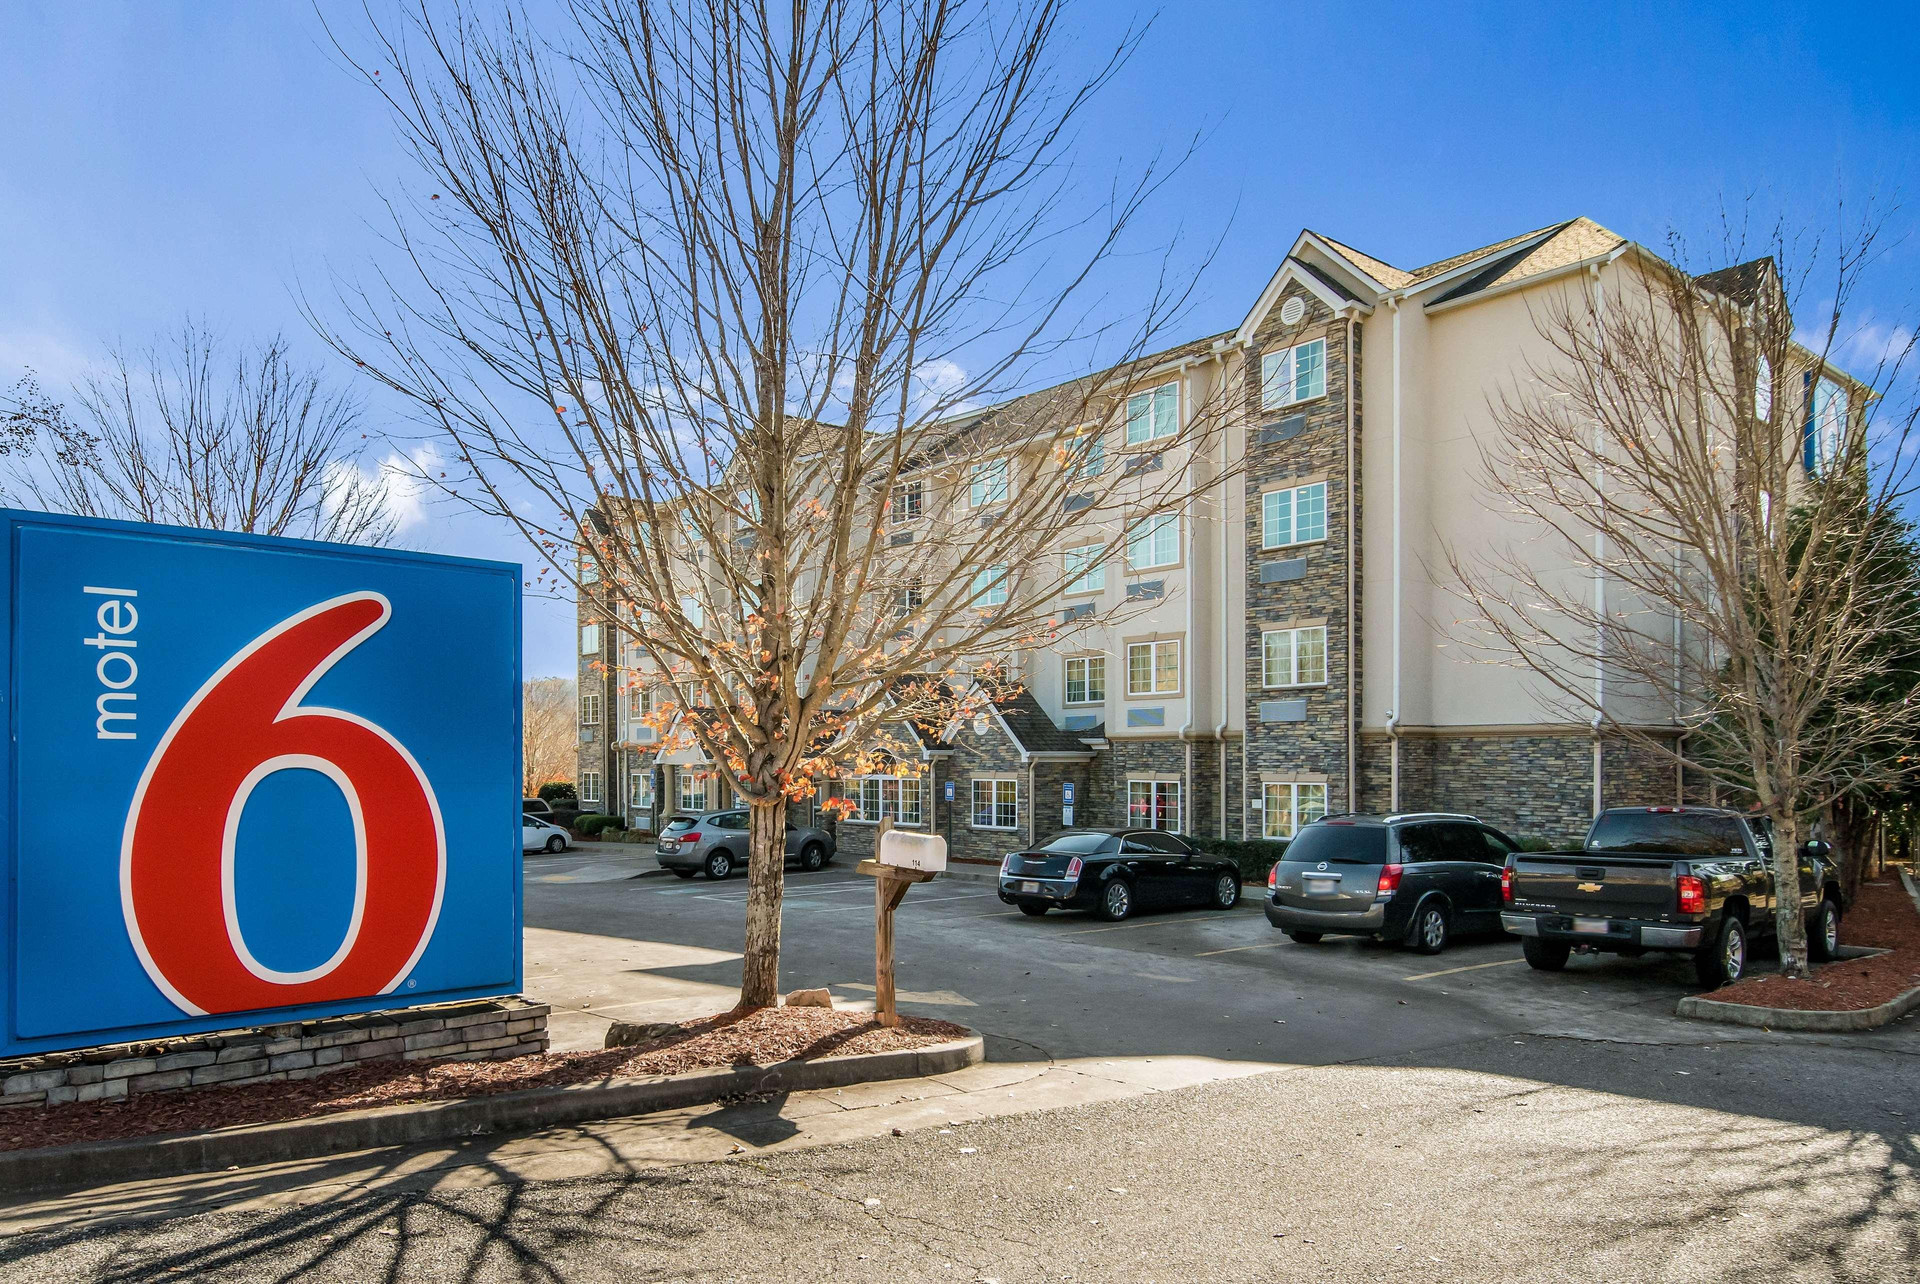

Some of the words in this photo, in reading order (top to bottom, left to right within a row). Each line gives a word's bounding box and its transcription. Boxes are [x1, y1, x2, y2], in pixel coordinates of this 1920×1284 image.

[82, 585, 139, 740] motel
[119, 590, 447, 1017] 6
[911, 859, 921, 867] 114
